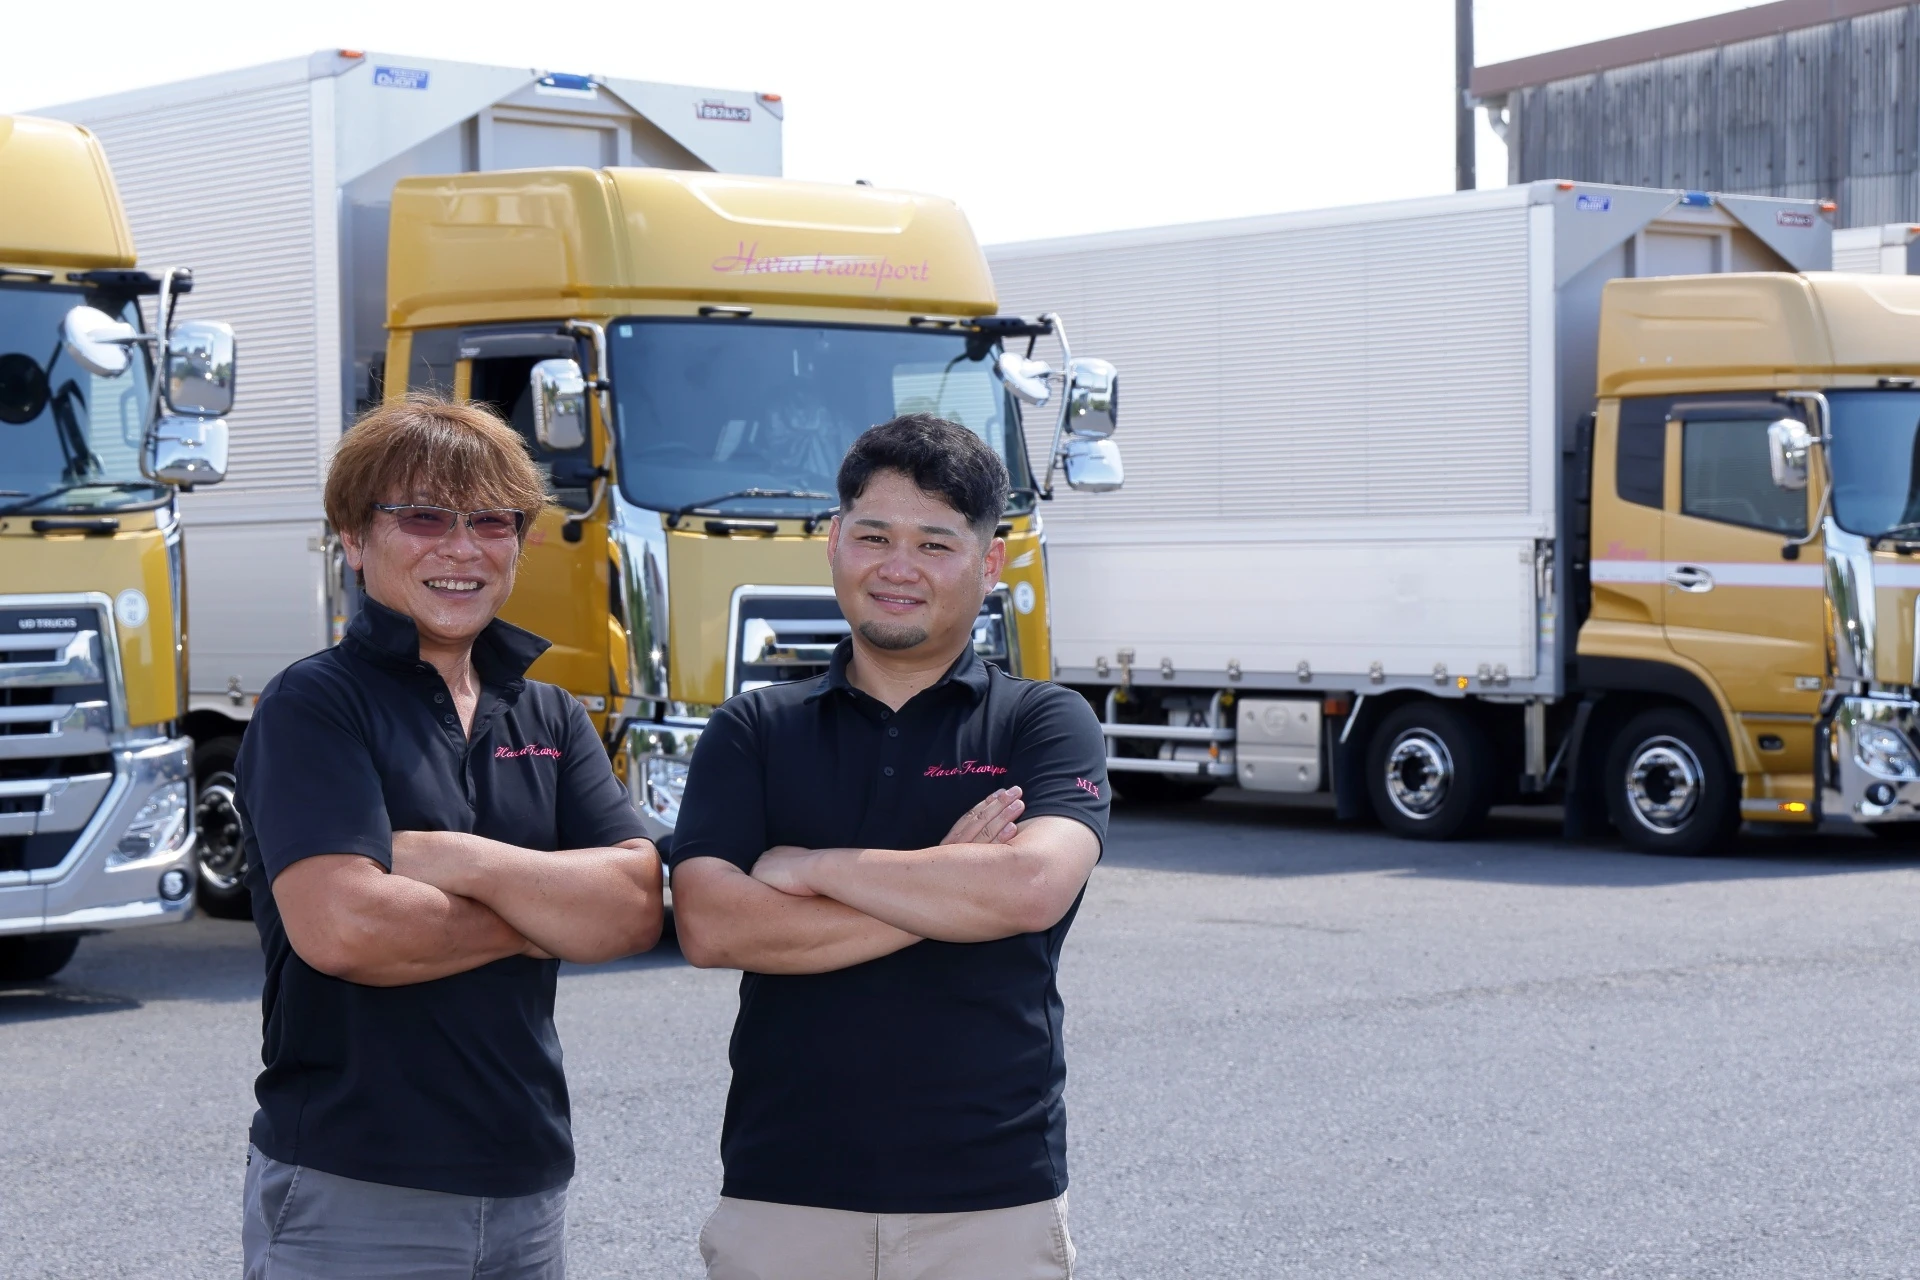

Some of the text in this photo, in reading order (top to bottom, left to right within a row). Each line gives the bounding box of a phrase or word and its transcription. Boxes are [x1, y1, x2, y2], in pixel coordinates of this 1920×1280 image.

[712, 241, 929, 291] Hara transport
[36, 617, 77, 628] TRUCKS
[495, 746, 527, 758] Hara
[923, 760, 1007, 777] Hara Transpo
